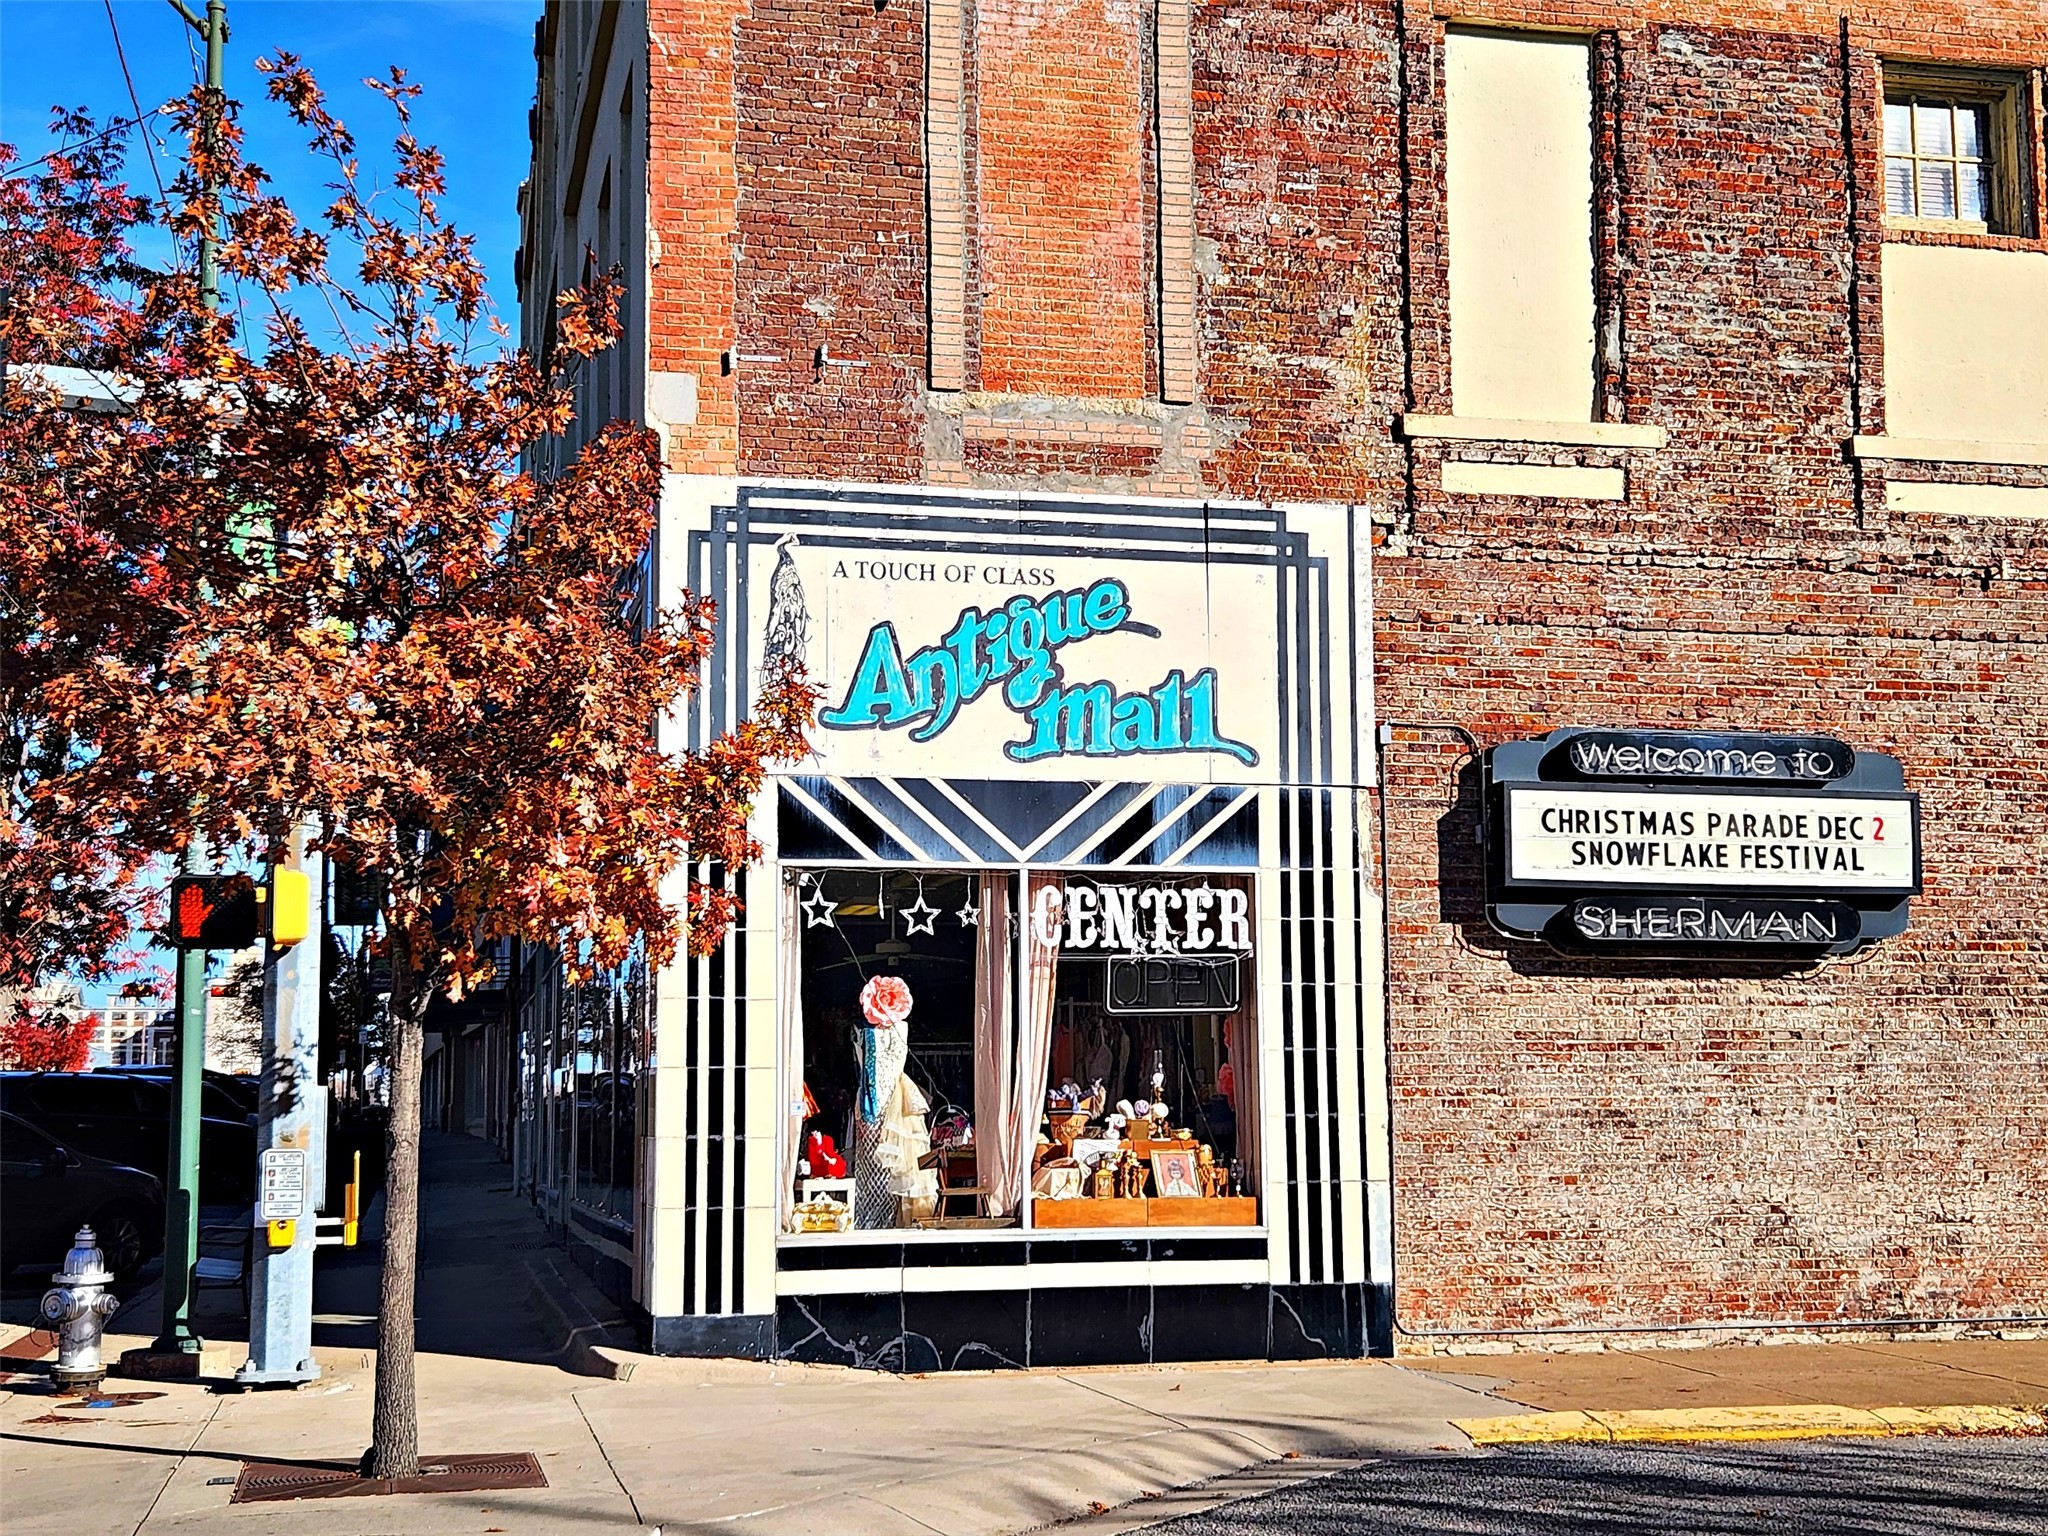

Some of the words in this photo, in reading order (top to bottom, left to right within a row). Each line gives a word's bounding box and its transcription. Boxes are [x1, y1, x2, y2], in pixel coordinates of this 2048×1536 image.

[833, 560, 847, 579] A
[855, 561, 936, 582] TOUCH
[944, 565, 976, 584] OF
[983, 566, 1056, 587] CLASS
[1577, 742, 1777, 775] Welcome
[1541, 808, 1695, 836] CHRISTMAS
[1708, 813, 1809, 839] PARADE
[1818, 816, 1865, 841] DEC
[1872, 816, 1885, 841] 2
[1572, 841, 1729, 868] SNOWFLAKE
[1740, 844, 1865, 871] FESTIVAL
[1030, 884, 1253, 951] CENTER
[1580, 905, 1837, 939] SHERMAN
[1112, 960, 1234, 1006] OPEN
